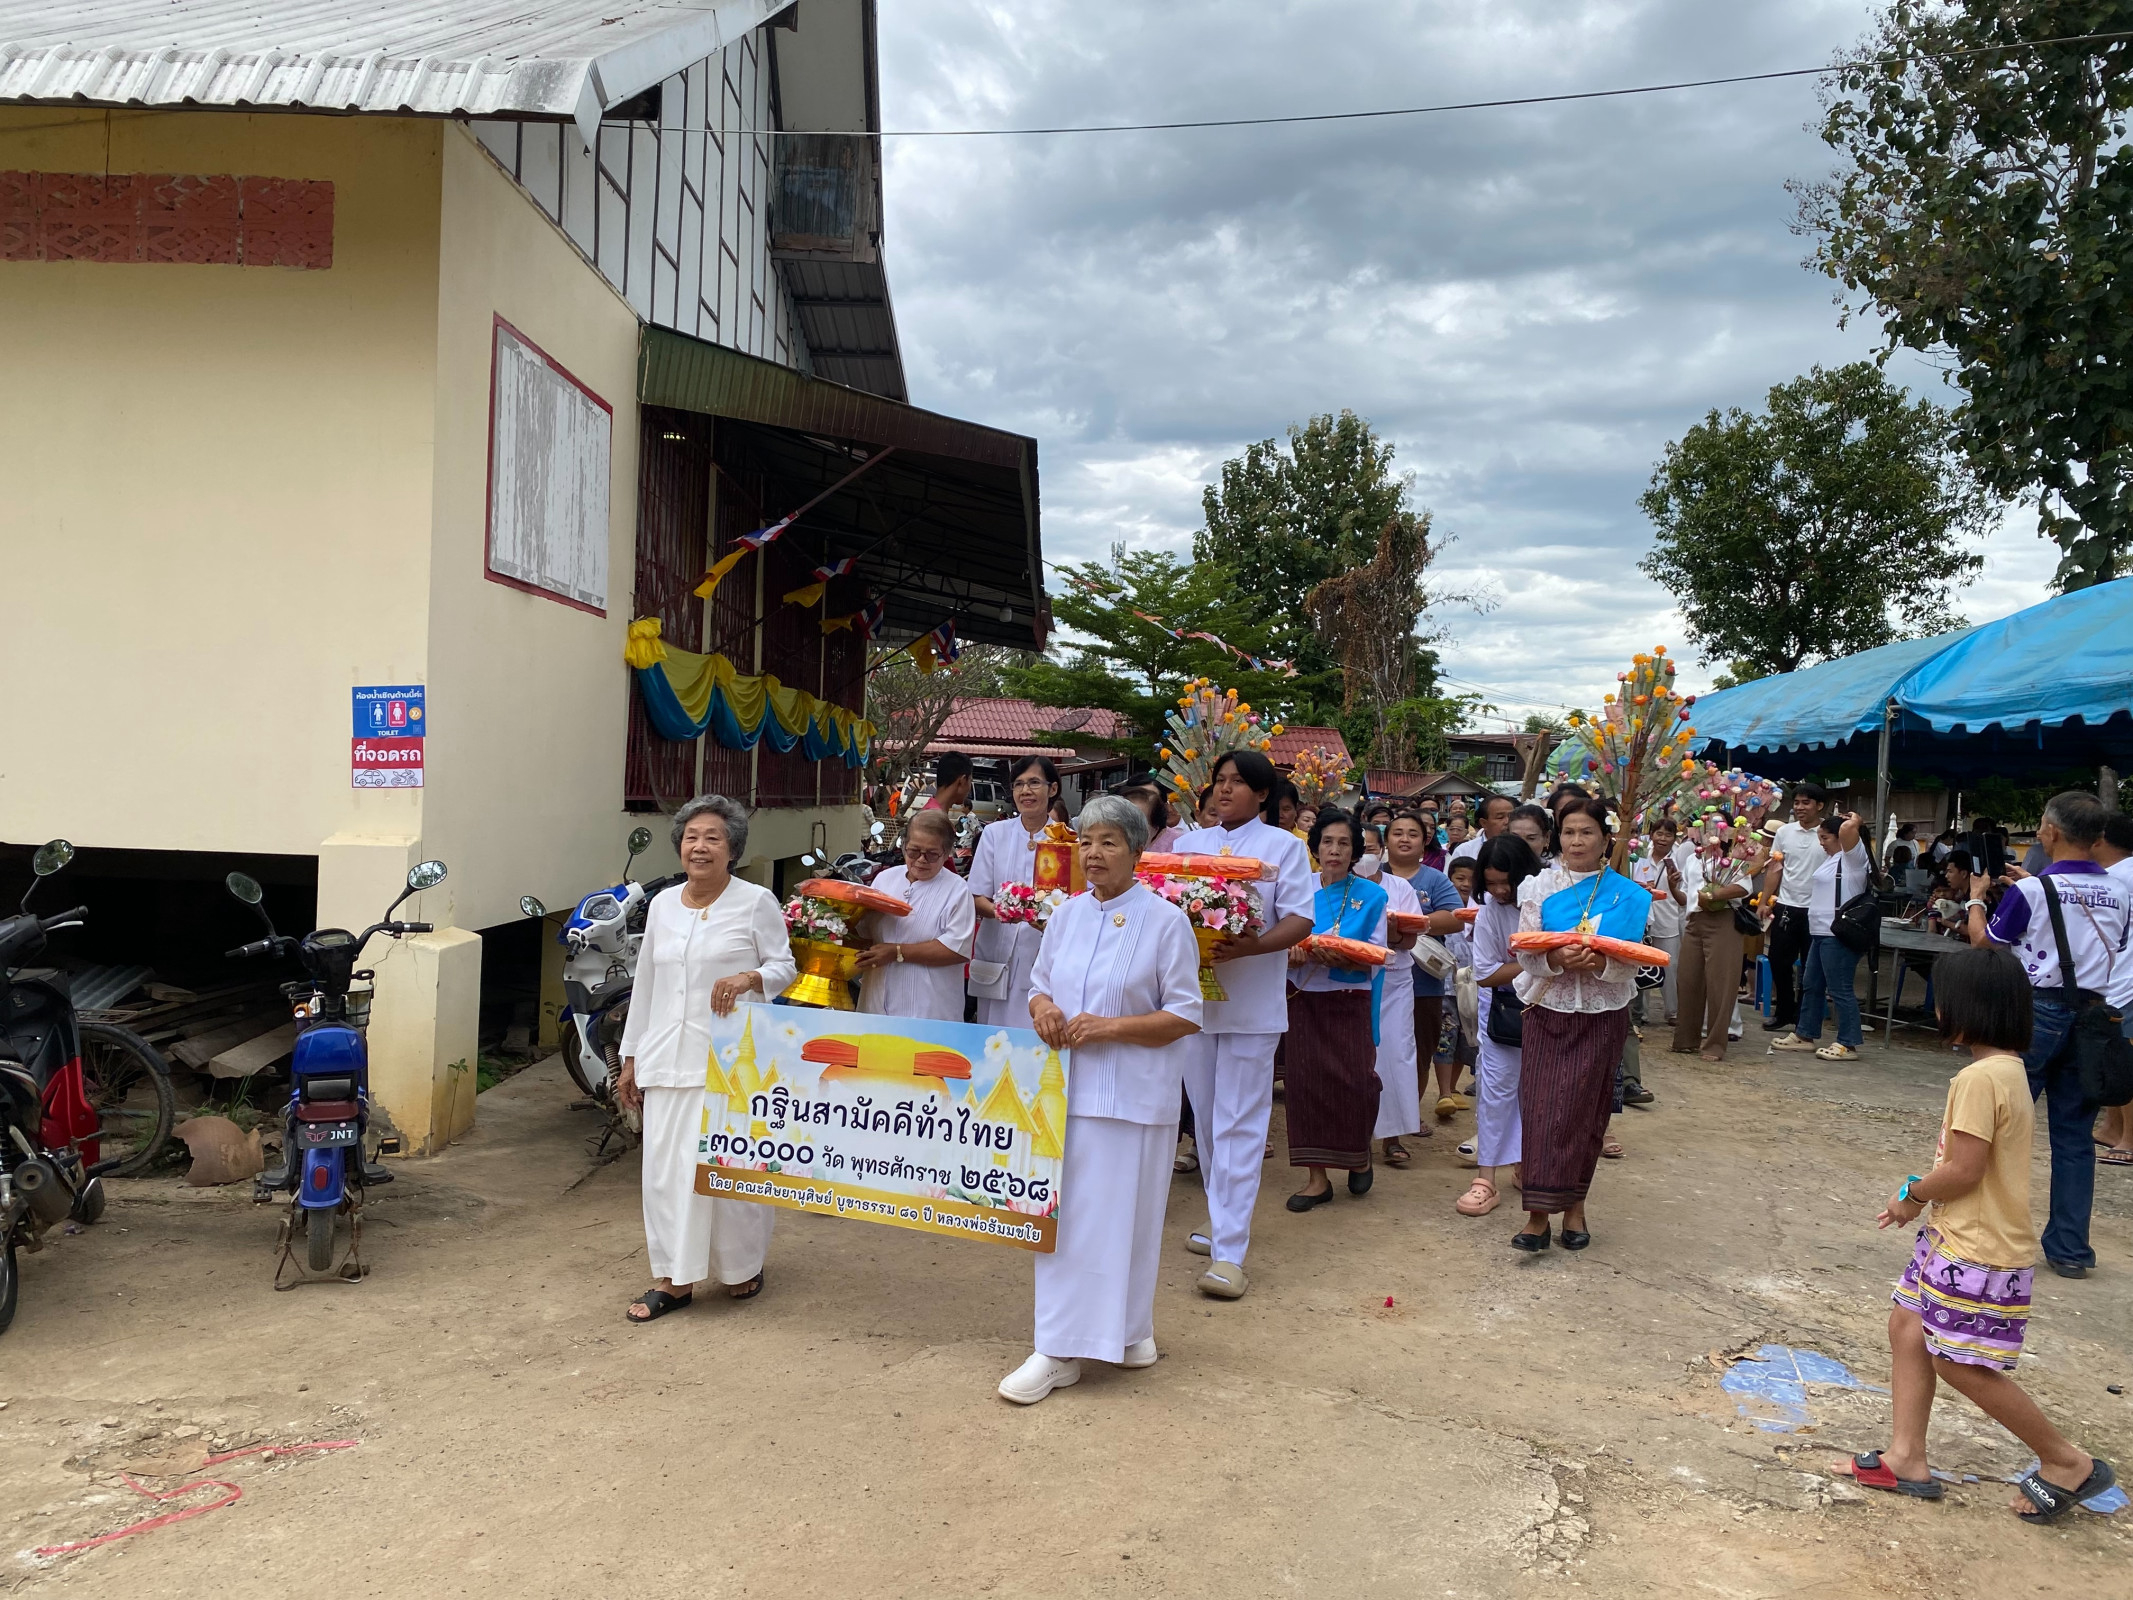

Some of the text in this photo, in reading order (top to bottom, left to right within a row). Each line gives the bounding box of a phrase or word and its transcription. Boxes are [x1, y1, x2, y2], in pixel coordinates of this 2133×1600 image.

[354, 741, 421, 762] ที่จอดรถ
[330, 1130, 354, 1140] JNT
[751, 1086, 1014, 1150] กฐินสามัคคีทั่วไทย
[710, 1133, 1050, 1202] ๓๐,๐๐๐ วัด พุทธศักราช ๒๕๖๘
[709, 1173, 732, 1190] โดย
[736, 1181, 832, 1206] คณะศิษยานุศิษย์
[837, 1196, 895, 1215] บูชาธรรม
[900, 1208, 918, 1220] ๘๑
[923, 1206, 933, 1222] ปี
[2026, 1477, 2056, 1508] ADDA
